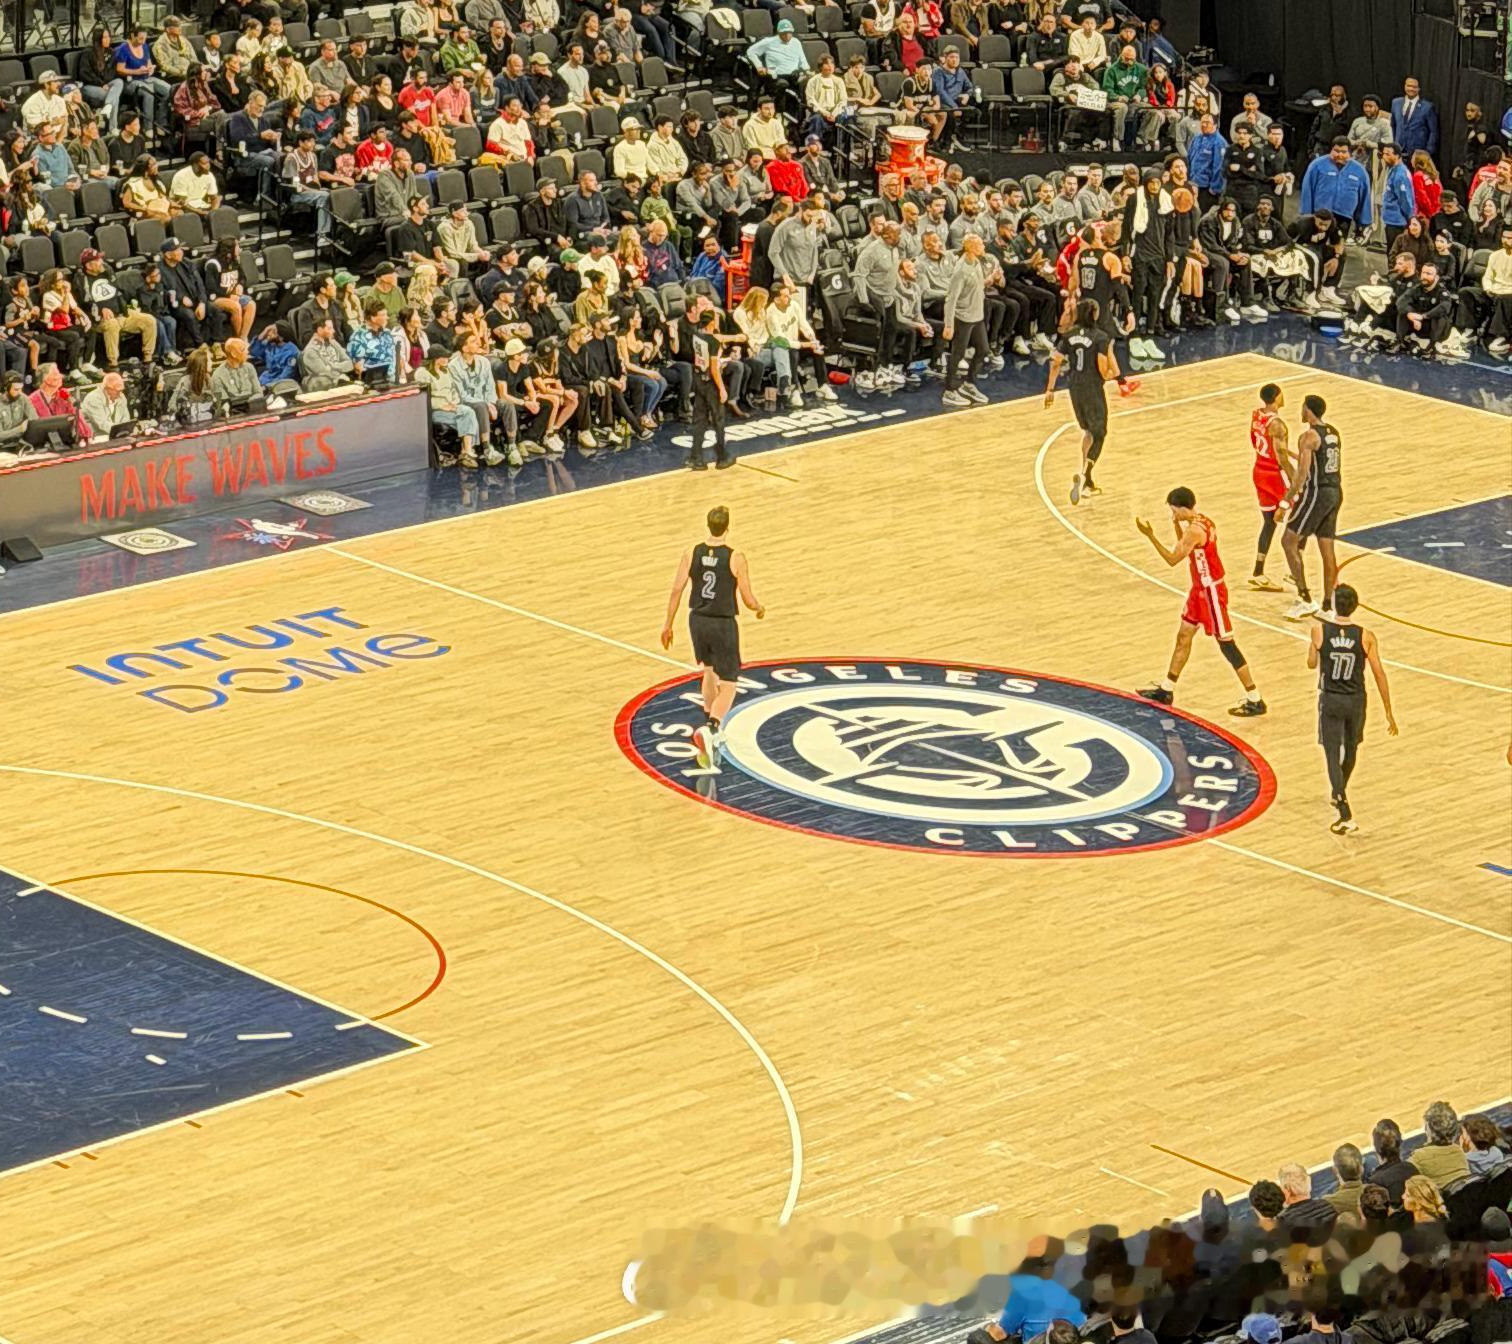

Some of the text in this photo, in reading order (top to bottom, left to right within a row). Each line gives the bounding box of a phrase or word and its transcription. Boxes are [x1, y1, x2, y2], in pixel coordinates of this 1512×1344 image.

[80, 427, 337, 524] MAKE WAVES
[702, 571, 716, 599] 2
[1330, 652, 1355, 680] 77
[924, 754, 1239, 850] CLIPPERS
